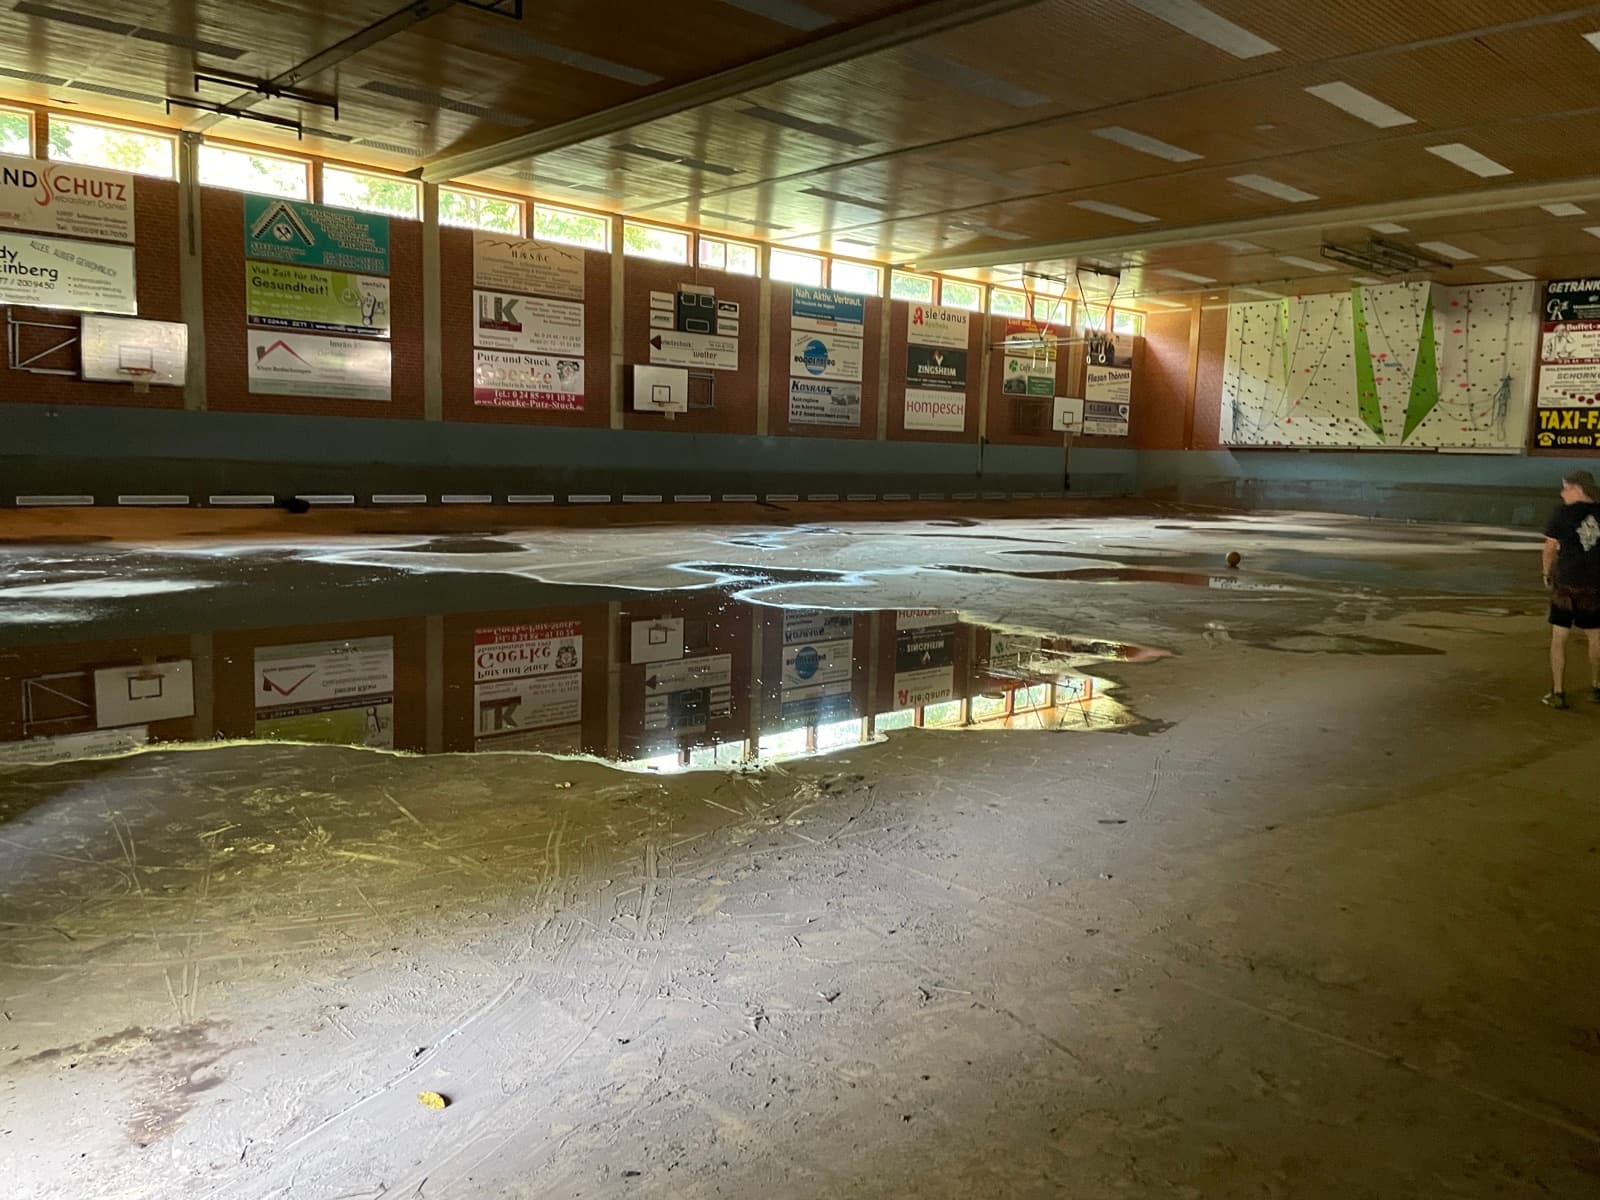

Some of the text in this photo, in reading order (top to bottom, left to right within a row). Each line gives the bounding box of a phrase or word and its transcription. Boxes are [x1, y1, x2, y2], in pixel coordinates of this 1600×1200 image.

[0, 165, 126, 206] NDSCHUTZ
[252, 265, 328, 283] Viel Zeit für Ihre
[252, 276, 328, 296] Gesundheit!
[796, 288, 862, 306] Nah. Aktiv. Vertraut.
[478, 352, 550, 366] Putz und Stuck
[918, 365, 956, 376] ZINGSHEIM
[1540, 411, 1600, 429] TAXI-F
